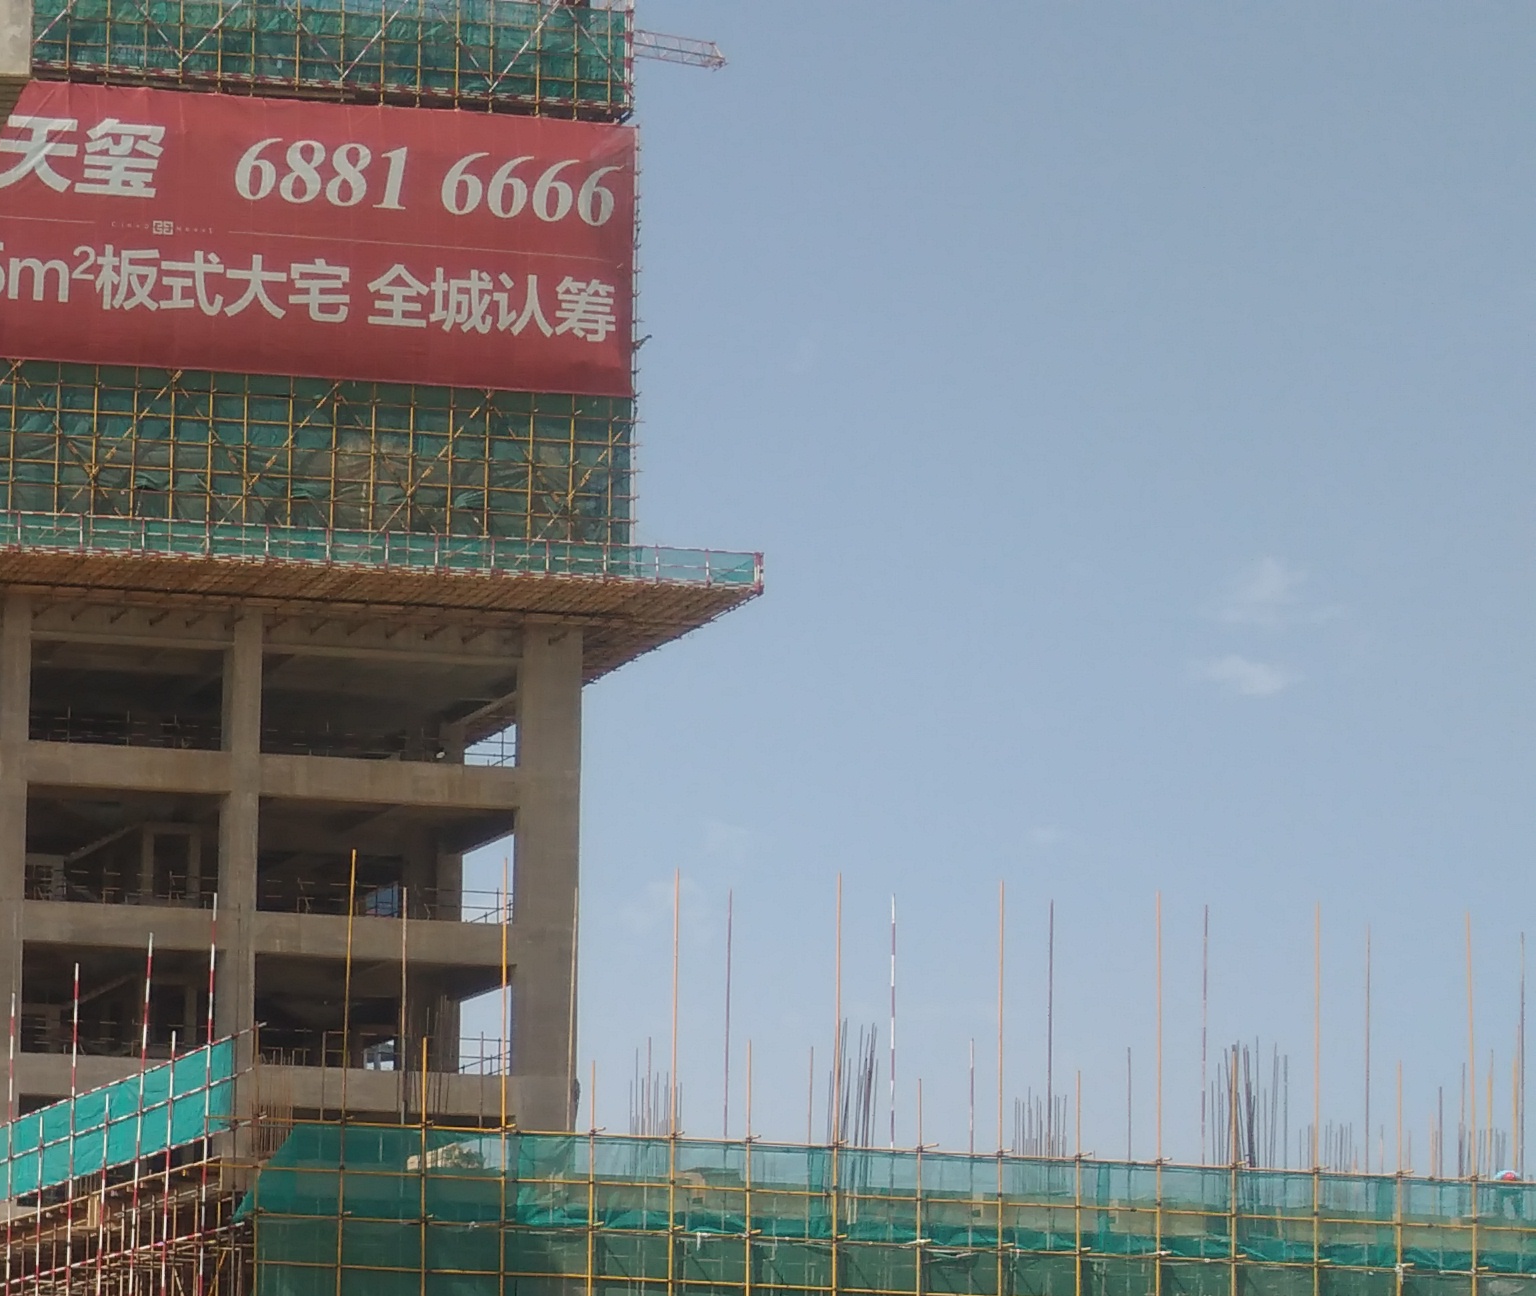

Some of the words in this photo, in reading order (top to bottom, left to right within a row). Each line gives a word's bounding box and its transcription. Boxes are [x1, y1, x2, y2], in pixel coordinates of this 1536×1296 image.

[235, 138, 408, 210] 6881
[441, 152, 625, 226] 6666
[367, 263, 617, 342] 全城认筹
